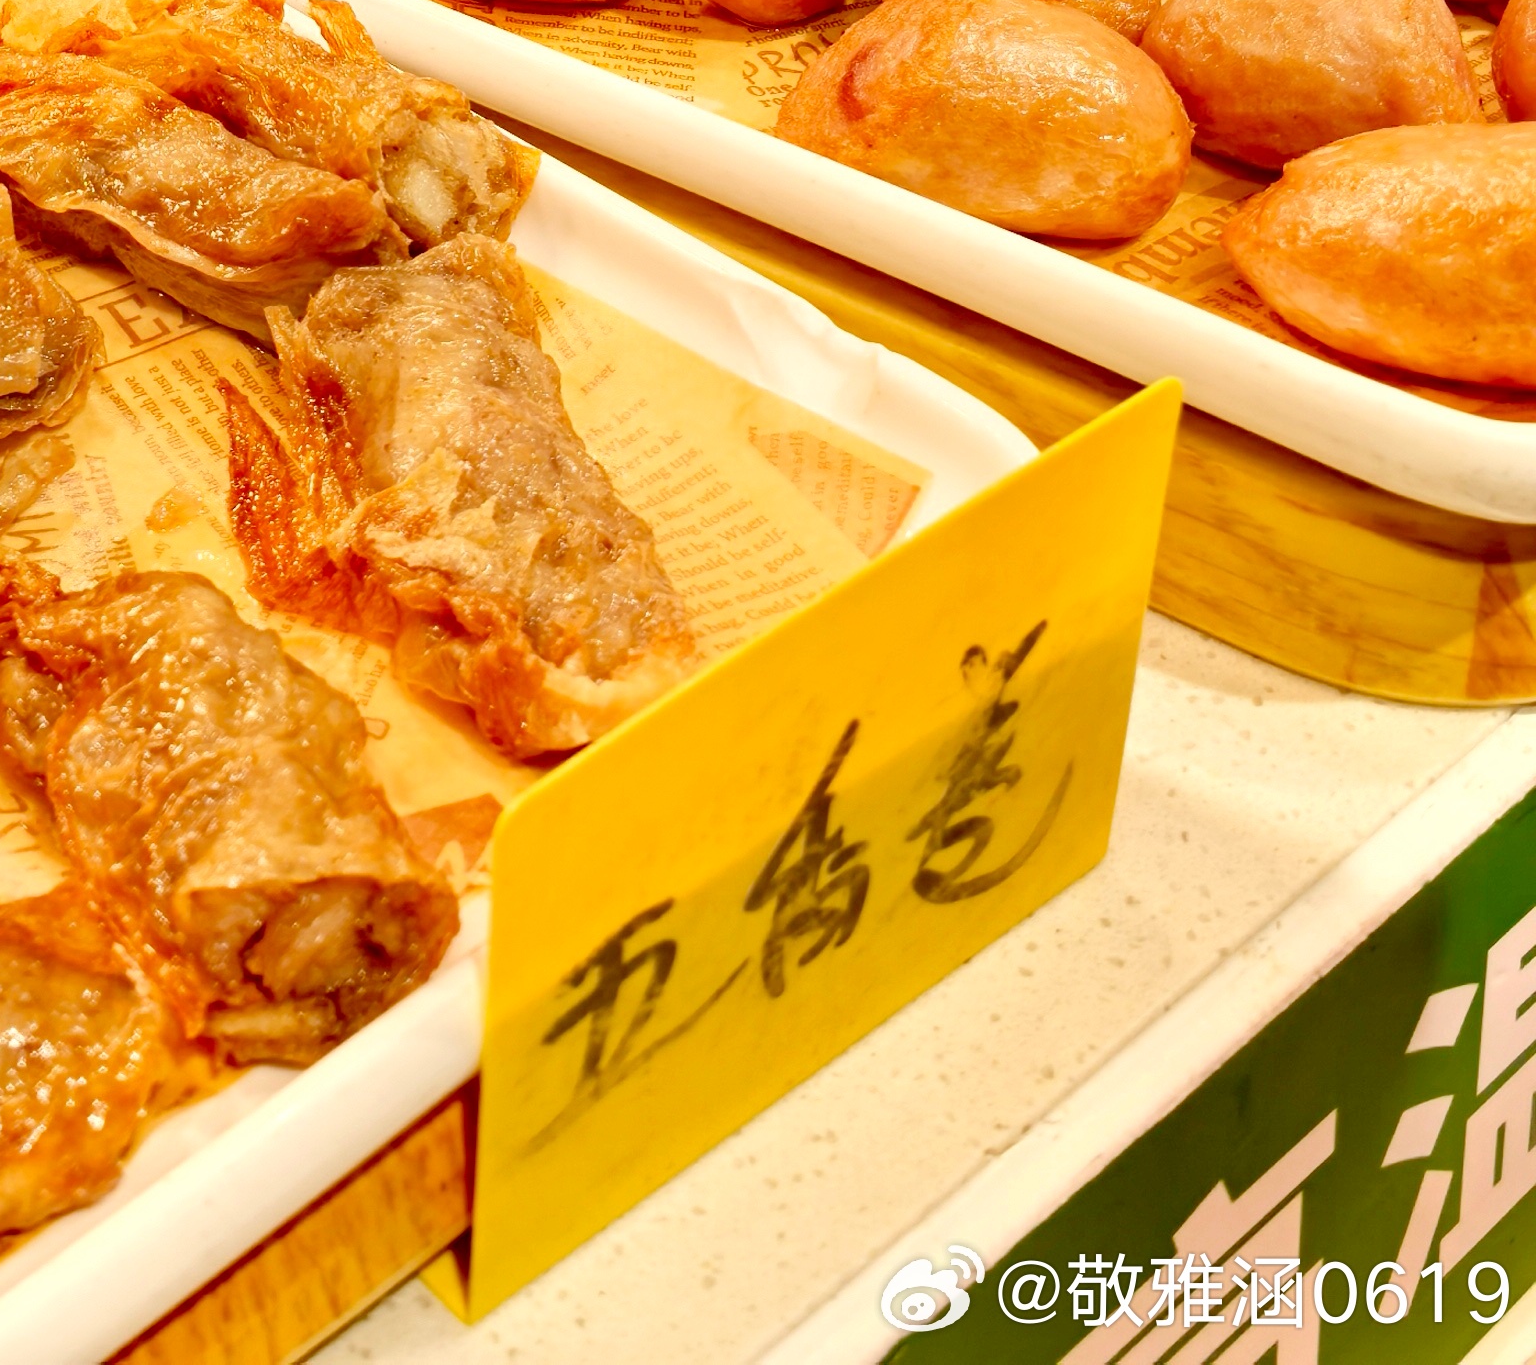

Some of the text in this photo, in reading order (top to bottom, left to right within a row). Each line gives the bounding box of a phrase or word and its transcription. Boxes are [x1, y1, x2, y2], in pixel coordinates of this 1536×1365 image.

[624, 15, 672, 31] having
[650, 69, 696, 82] When
[614, 397, 648, 425] love
[635, 463, 718, 511] ndifferent;
[696, 480, 732, 505] with
[655, 522, 696, 546] aving
[716, 513, 770, 543] When
[672, 555, 730, 582] Should
[764, 543, 806, 573] good
